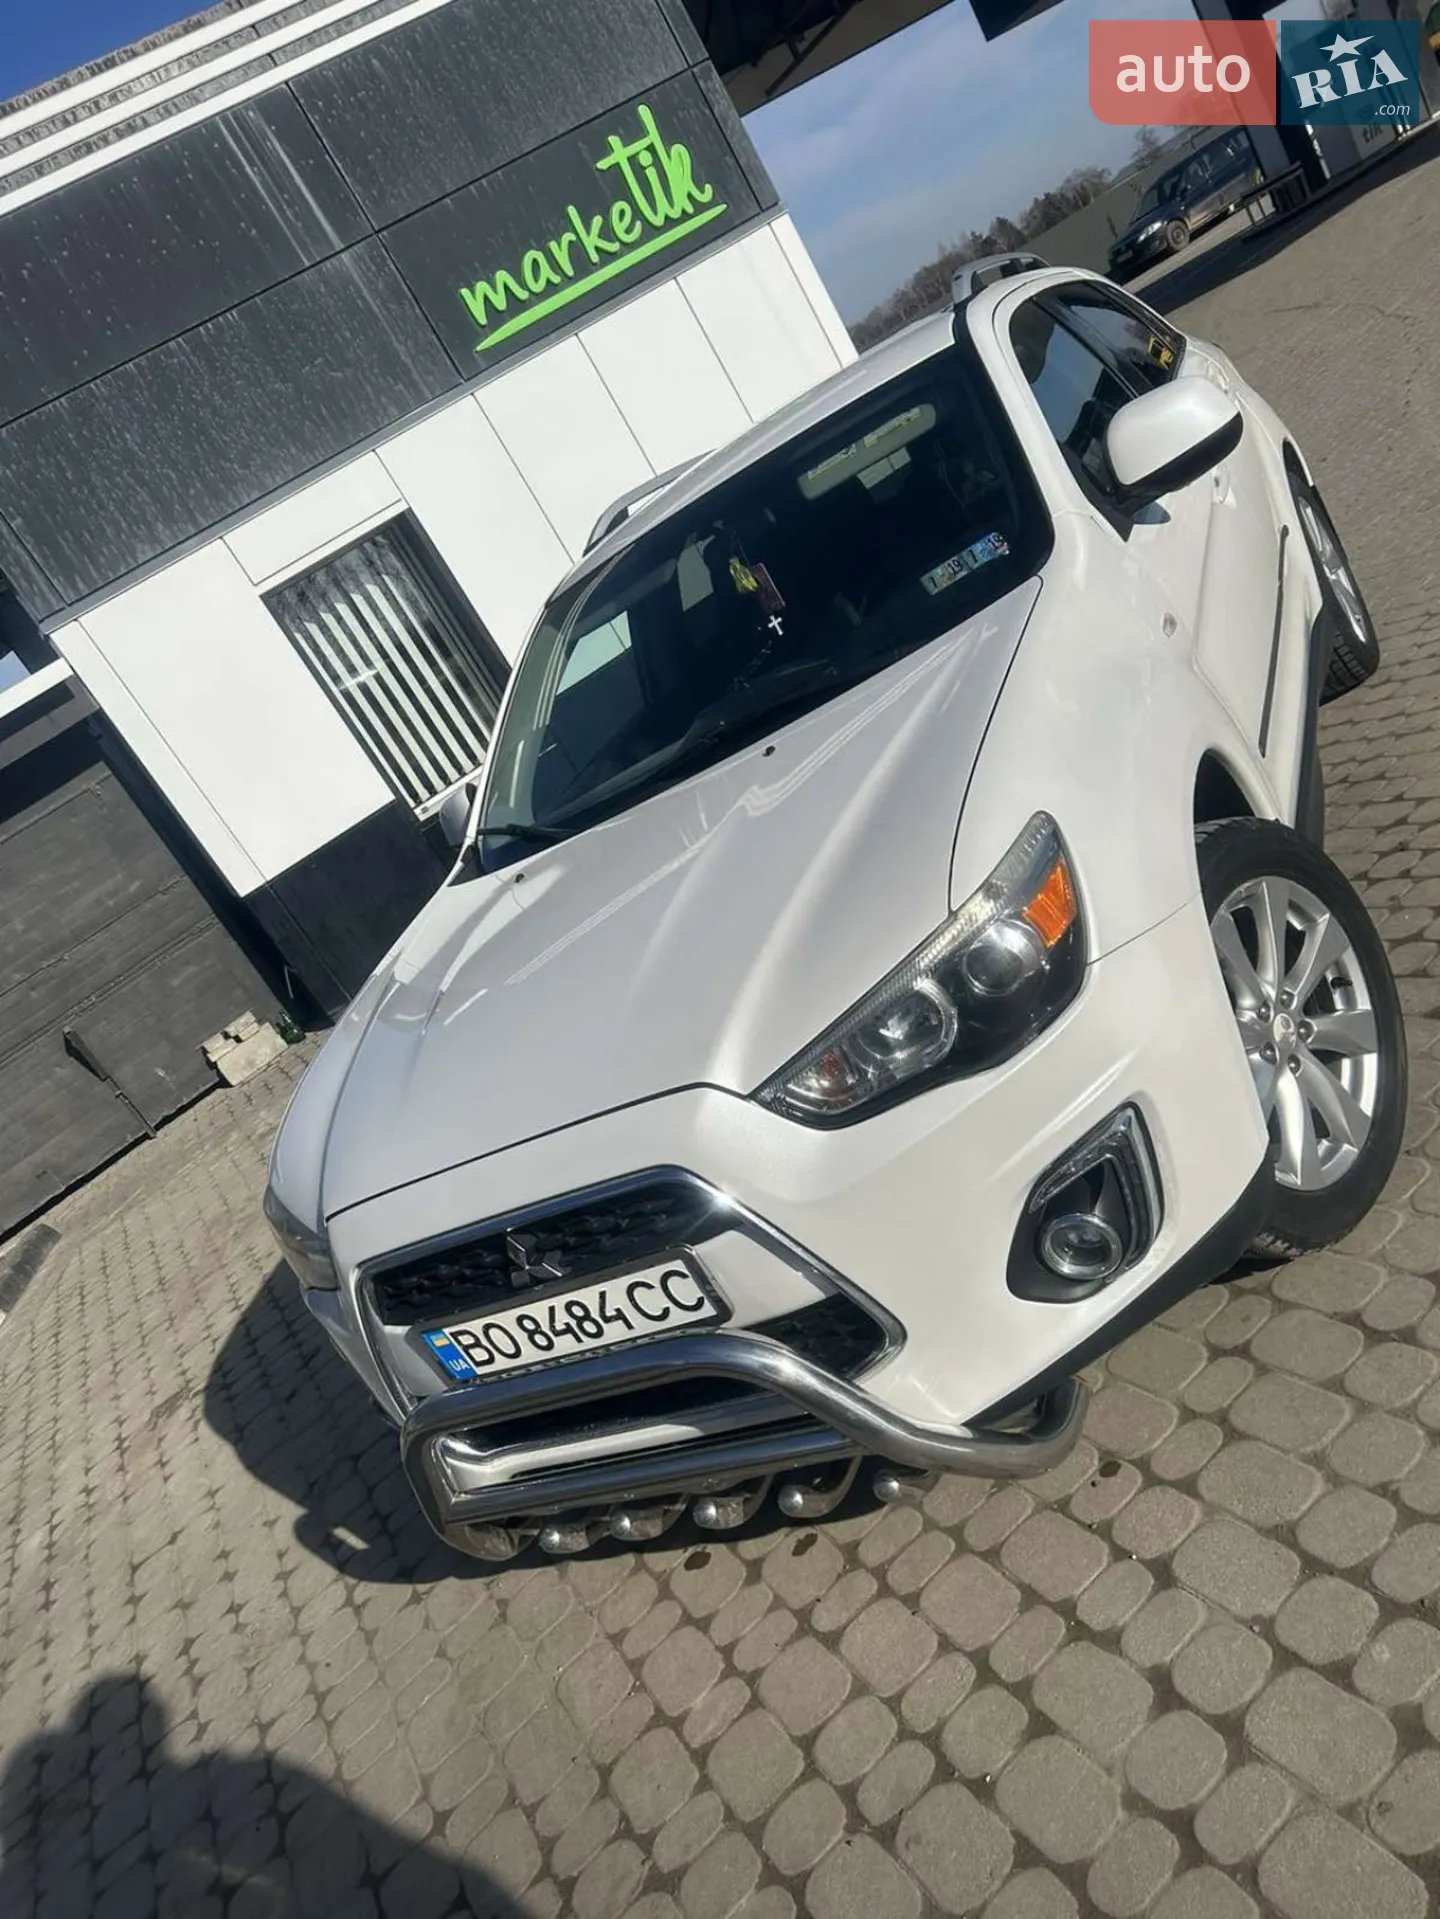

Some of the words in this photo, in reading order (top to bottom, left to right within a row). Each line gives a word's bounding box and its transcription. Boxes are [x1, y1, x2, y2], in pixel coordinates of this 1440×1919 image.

[459, 103, 714, 327] marketik
[449, 1321, 523, 1367] BO
[516, 1289, 635, 1351] 8484
[626, 1269, 705, 1322] CC
[449, 1358, 471, 1372] UA
